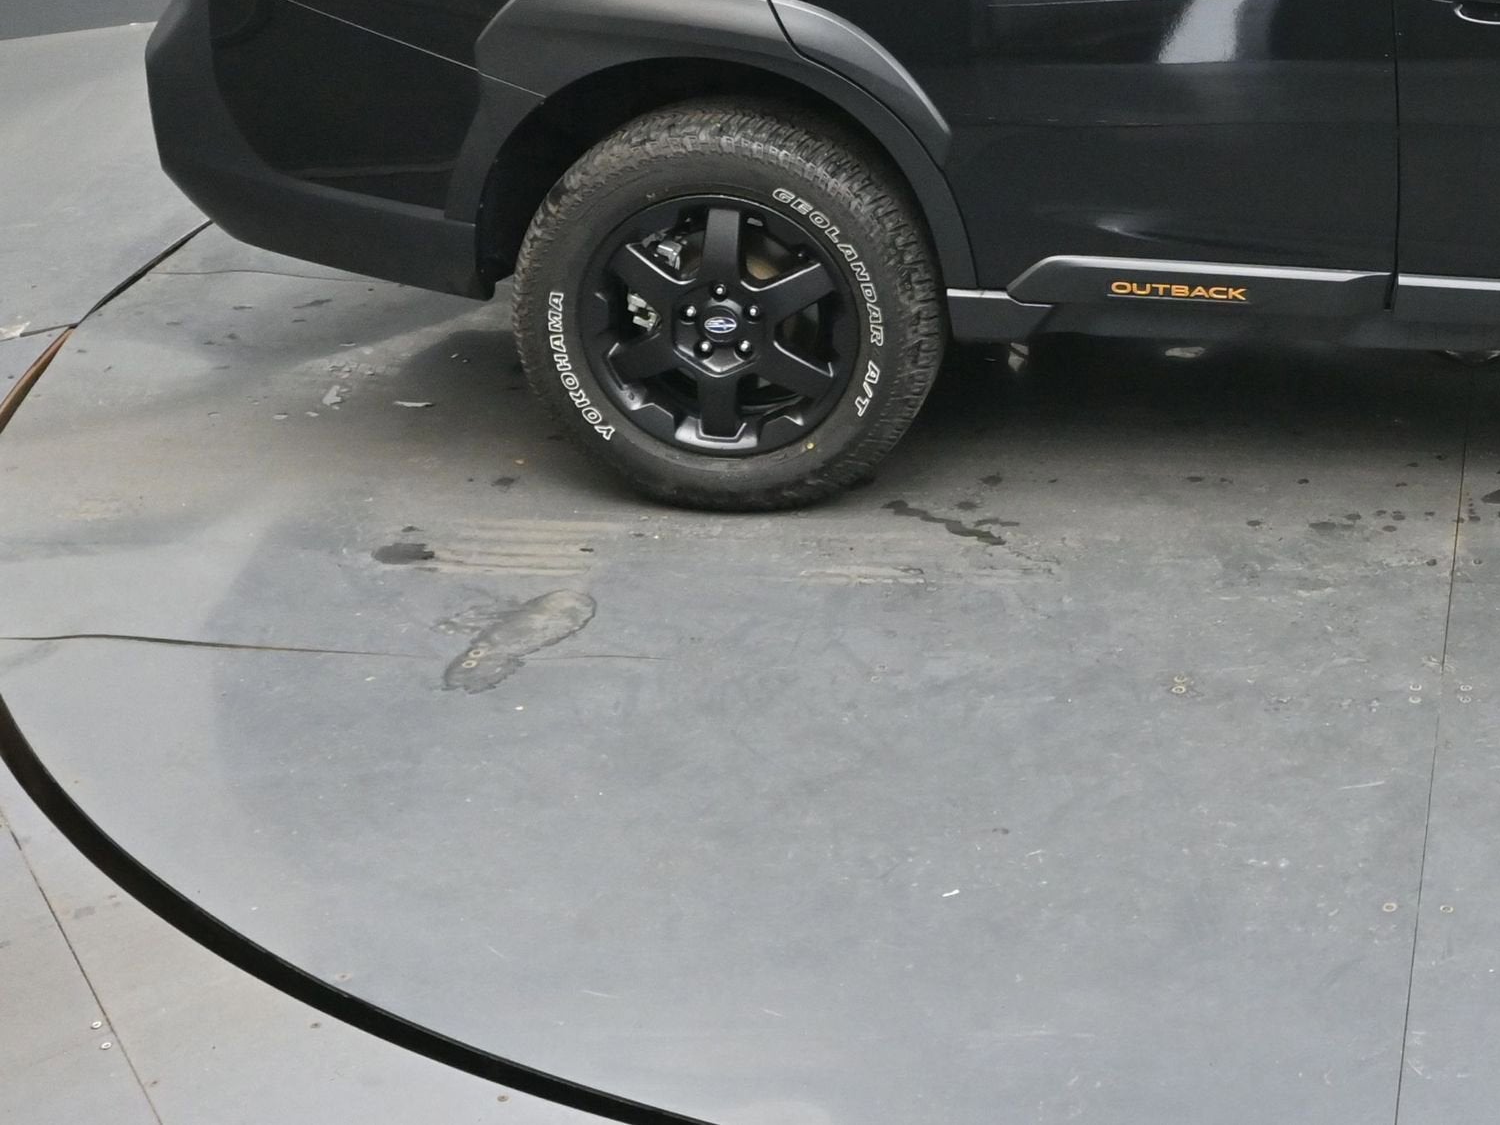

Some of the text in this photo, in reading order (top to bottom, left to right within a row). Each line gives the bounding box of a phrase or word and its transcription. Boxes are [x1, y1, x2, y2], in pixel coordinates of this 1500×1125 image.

[548, 291, 616, 441] YOKOHAMA
[772, 188, 885, 417] GEOLANDAR A/T
[1111, 281, 1247, 301] OUTBACK
